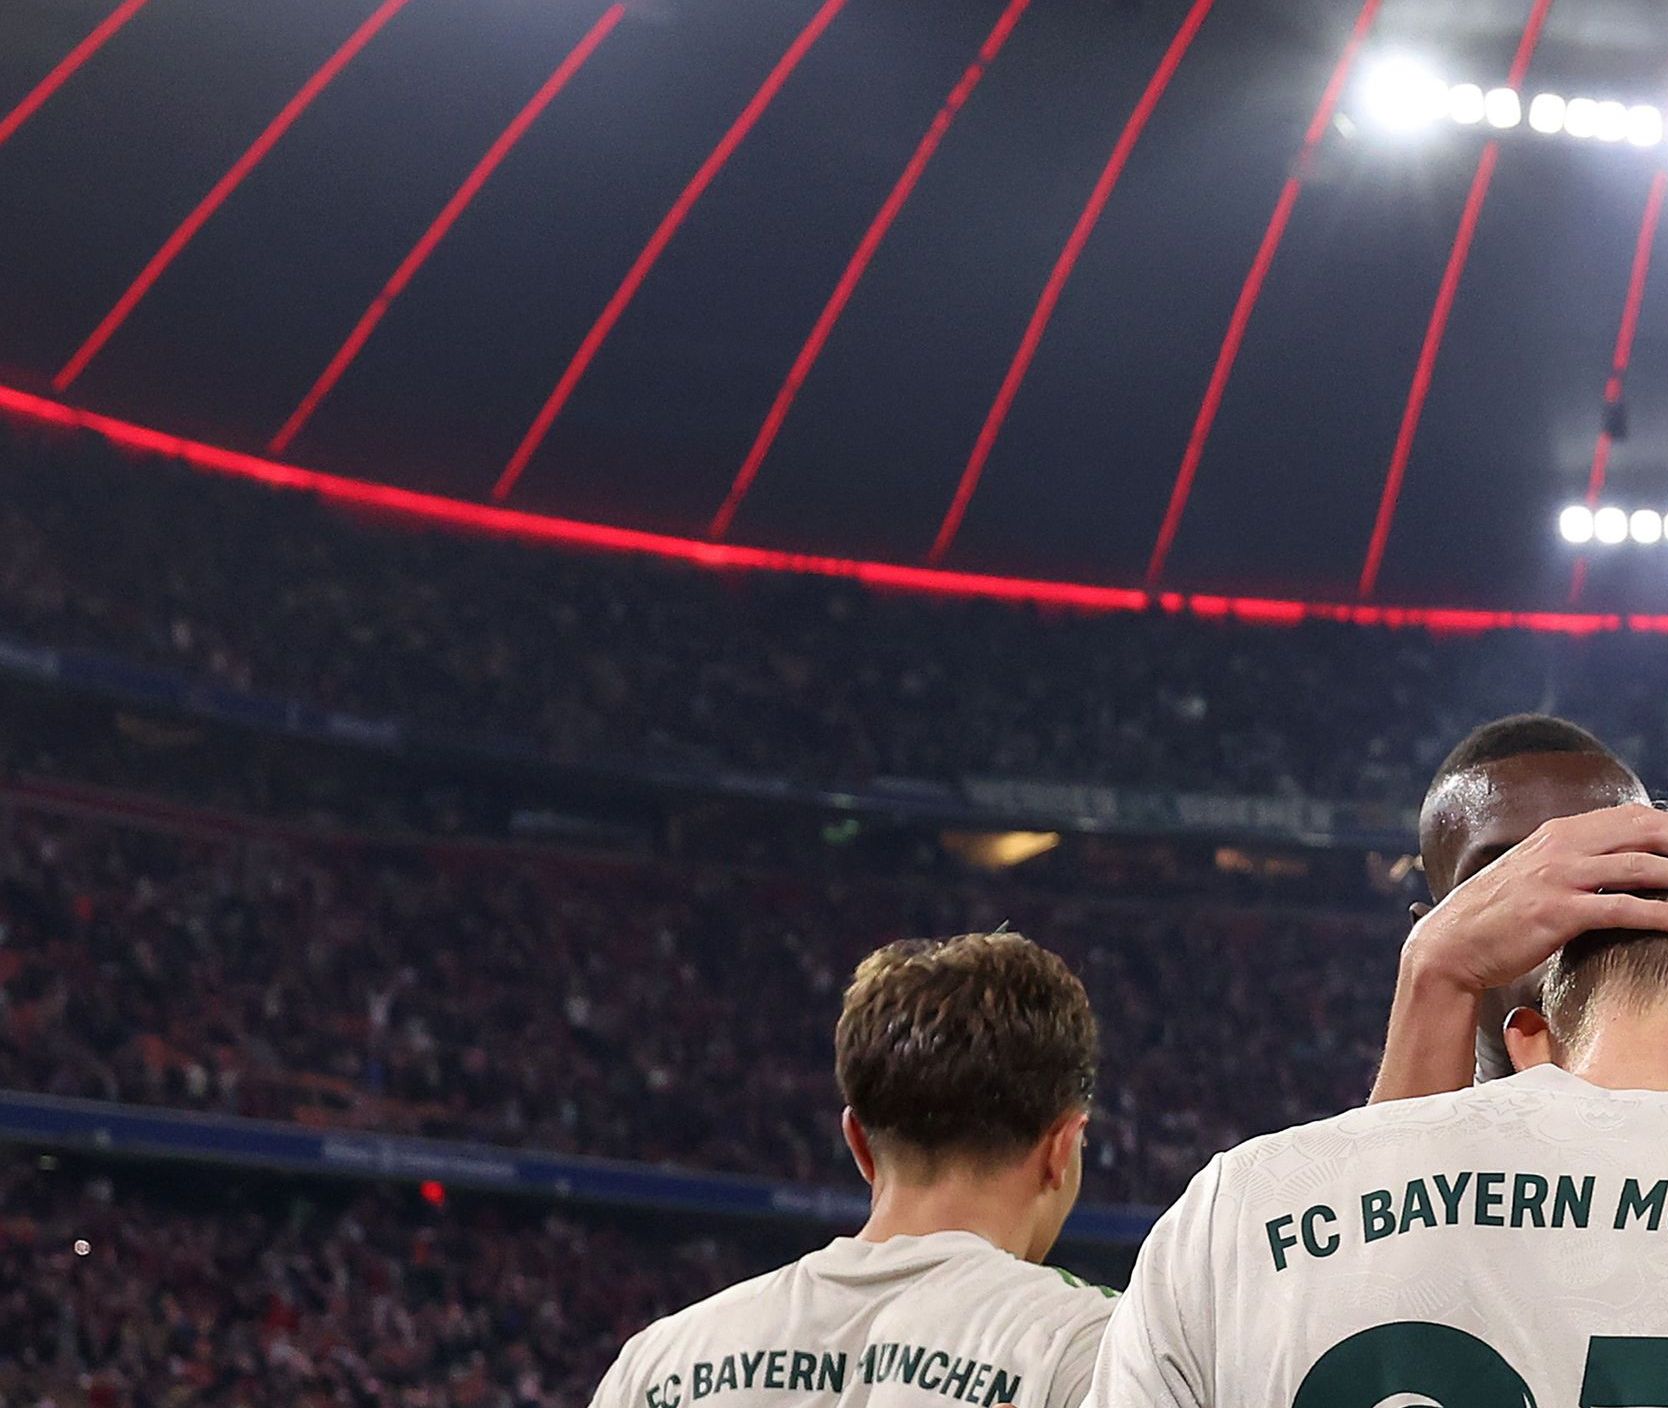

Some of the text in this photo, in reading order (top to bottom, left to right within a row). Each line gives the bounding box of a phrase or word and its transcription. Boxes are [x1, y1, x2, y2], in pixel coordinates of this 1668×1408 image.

[1265, 1203, 1341, 1272] FC
[1361, 1171, 1596, 1244] BAYERN
[692, 1349, 848, 1400] BAYERN
